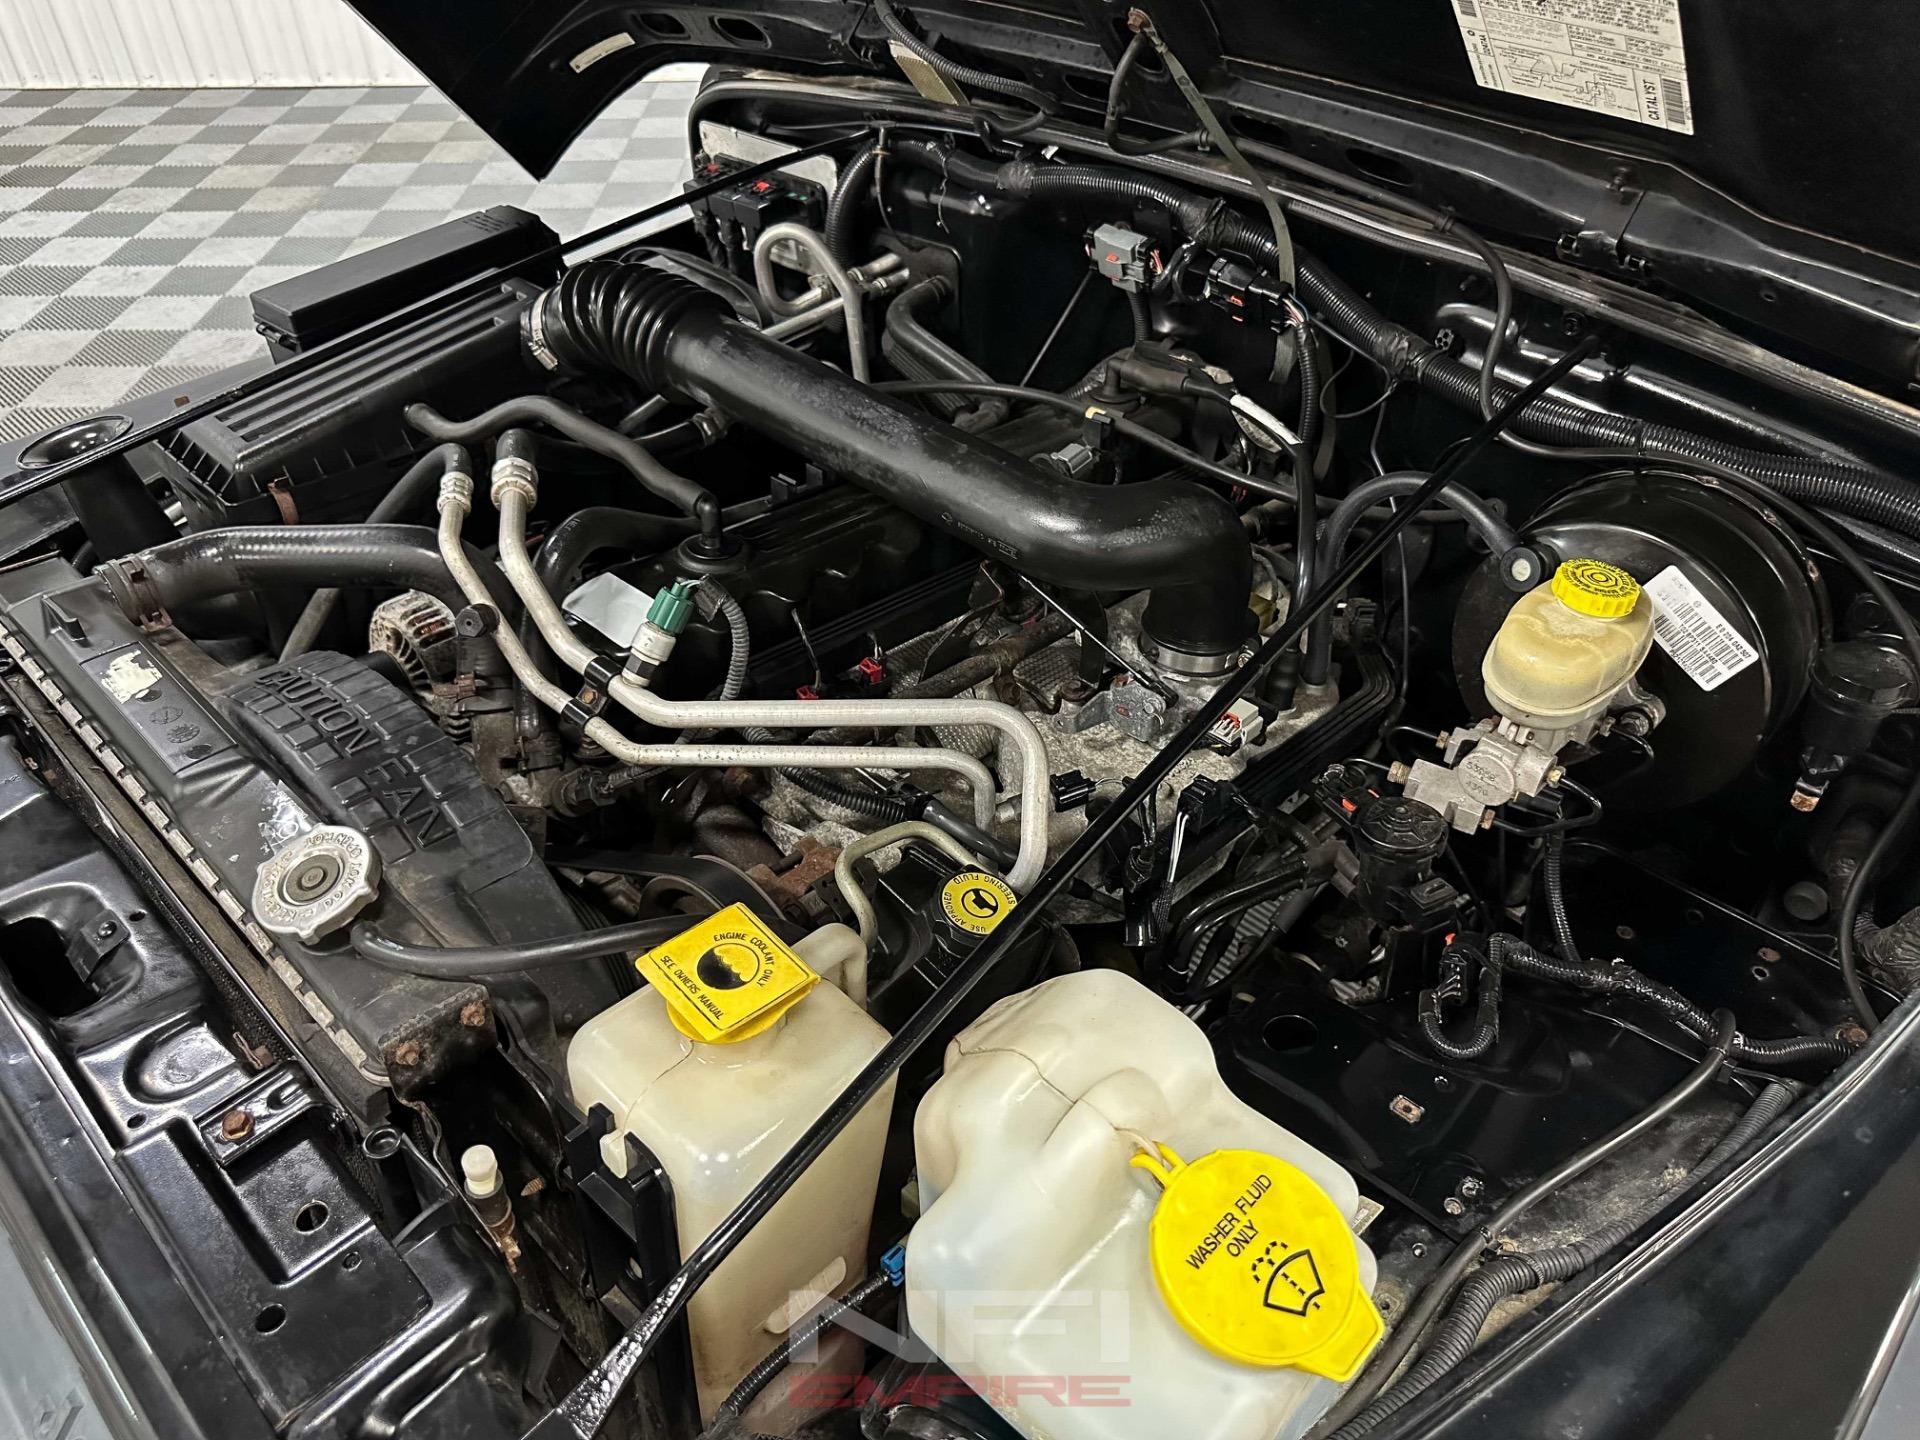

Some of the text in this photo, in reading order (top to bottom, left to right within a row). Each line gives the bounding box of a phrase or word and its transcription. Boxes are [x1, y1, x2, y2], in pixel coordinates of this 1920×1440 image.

[1642, 79, 1660, 120] CATALYST
[255, 670, 381, 753] CAUTION
[365, 758, 456, 848] FAN
[944, 891, 967, 926] APPROVED
[953, 874, 1016, 905] STEERING FLUID
[713, 932, 775, 987] ENGINE COOLANT ONLY
[660, 955, 725, 1020] SEE OWNERS MANUAL
[1186, 1174, 1273, 1270] WASHER FLUID
[1227, 1219, 1259, 1257] ONLY
